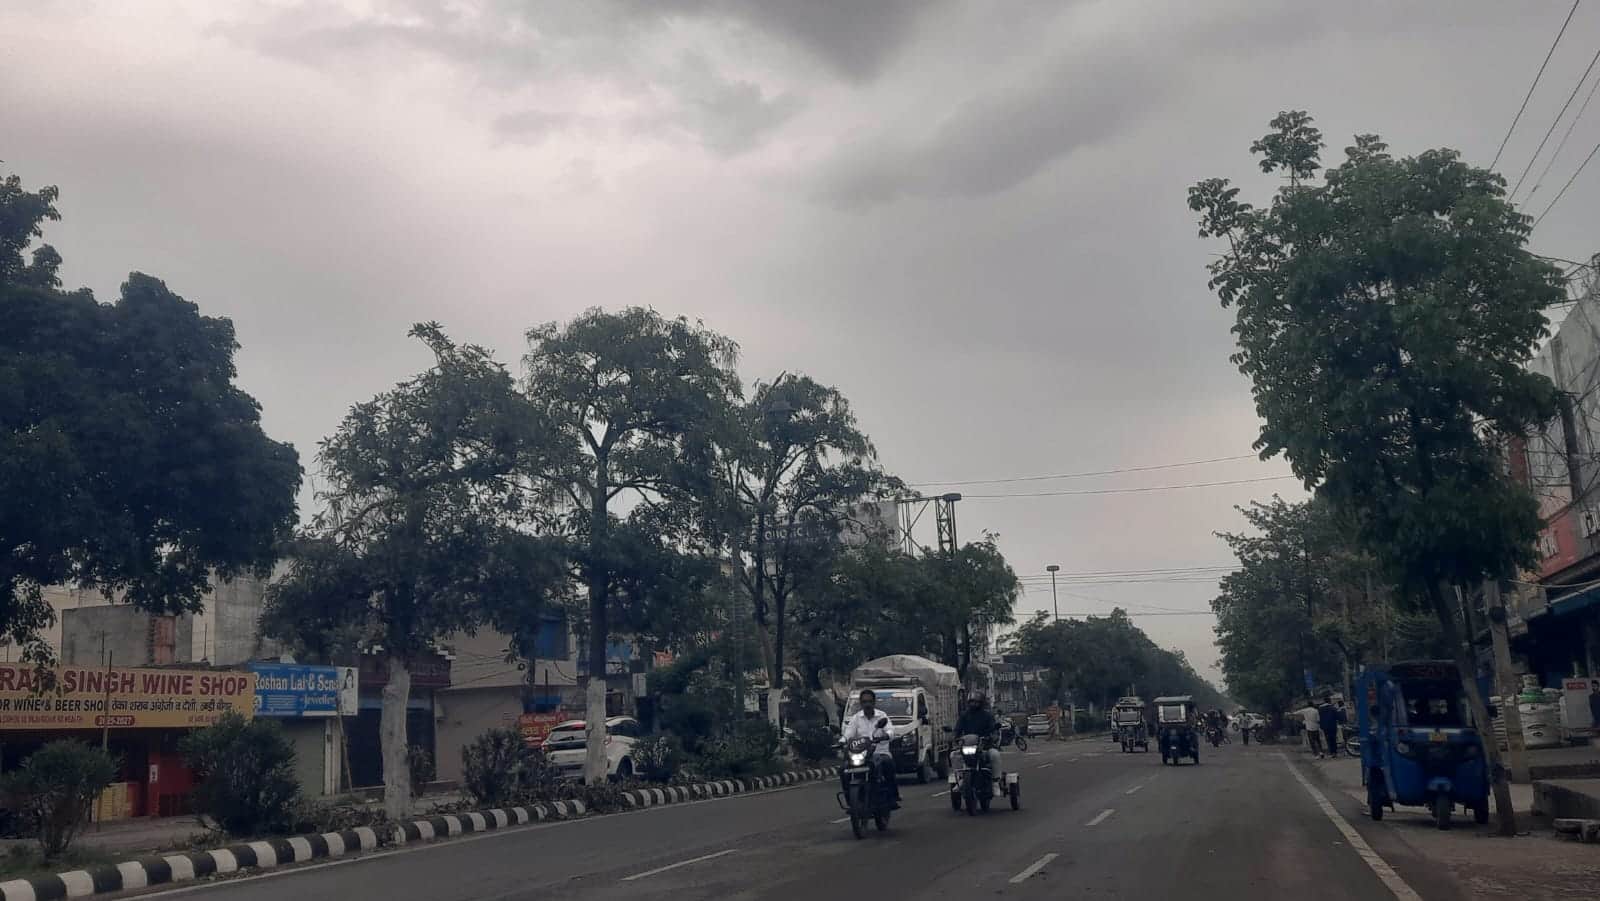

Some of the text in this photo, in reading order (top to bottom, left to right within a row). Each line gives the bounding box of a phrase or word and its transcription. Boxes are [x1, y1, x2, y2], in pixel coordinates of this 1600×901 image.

[63, 670, 135, 693] SINGH
[142, 673, 194, 695] WINE
[200, 674, 247, 696] SHOP
[13, 698, 41, 711] WINE
[55, 699, 80, 712] BEER
